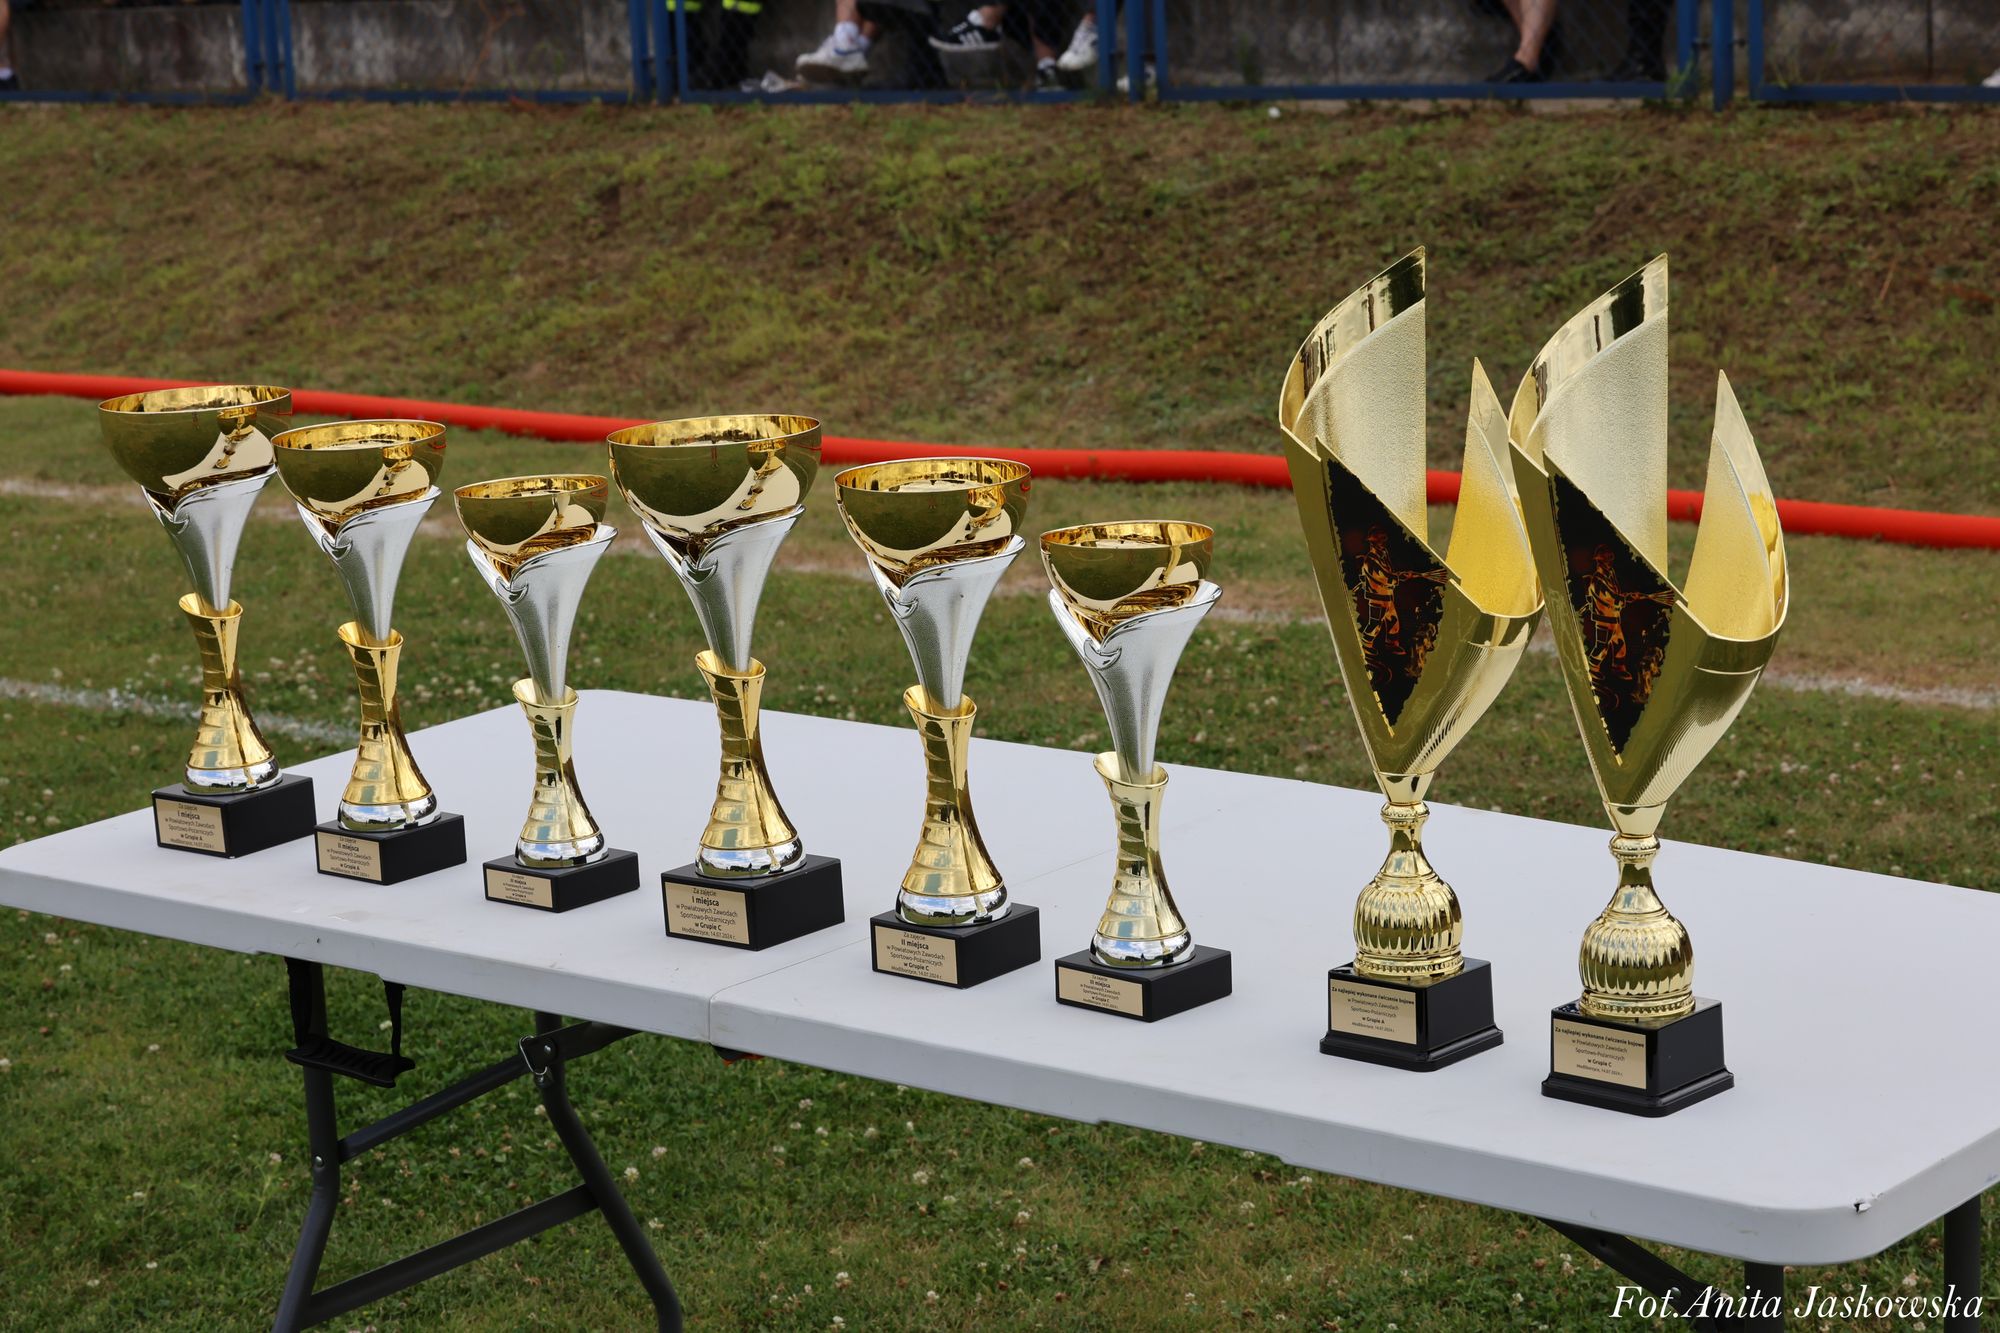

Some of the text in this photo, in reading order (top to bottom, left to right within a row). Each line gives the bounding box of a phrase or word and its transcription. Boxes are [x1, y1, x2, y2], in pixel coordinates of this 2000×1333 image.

[180, 811, 200, 821] miejsca
[342, 843, 359, 852] miejsca
[700, 888, 717, 897] zajęcie
[695, 896, 720, 908] miejsca
[681, 904, 712, 915] Powiatowych
[713, 908, 737, 918] Zawodach
[680, 911, 736, 926] Sportowo-Pożarniczych
[699, 922, 717, 931] Grupie
[906, 939, 929, 951] miejsca
[891, 945, 921, 957] Powiatowych
[922, 950, 945, 960] Zawodach
[908, 962, 924, 971] Grupie
[1095, 980, 1111, 990] miejsca
[1357, 991, 1377, 1000] wykonane
[1562, 1028, 1581, 1037] najlepiej
[1582, 1032, 1604, 1041] wykonane
[1628, 1040, 1644, 1049] bojowe
[1577, 1039, 1605, 1050] Powiatowych
